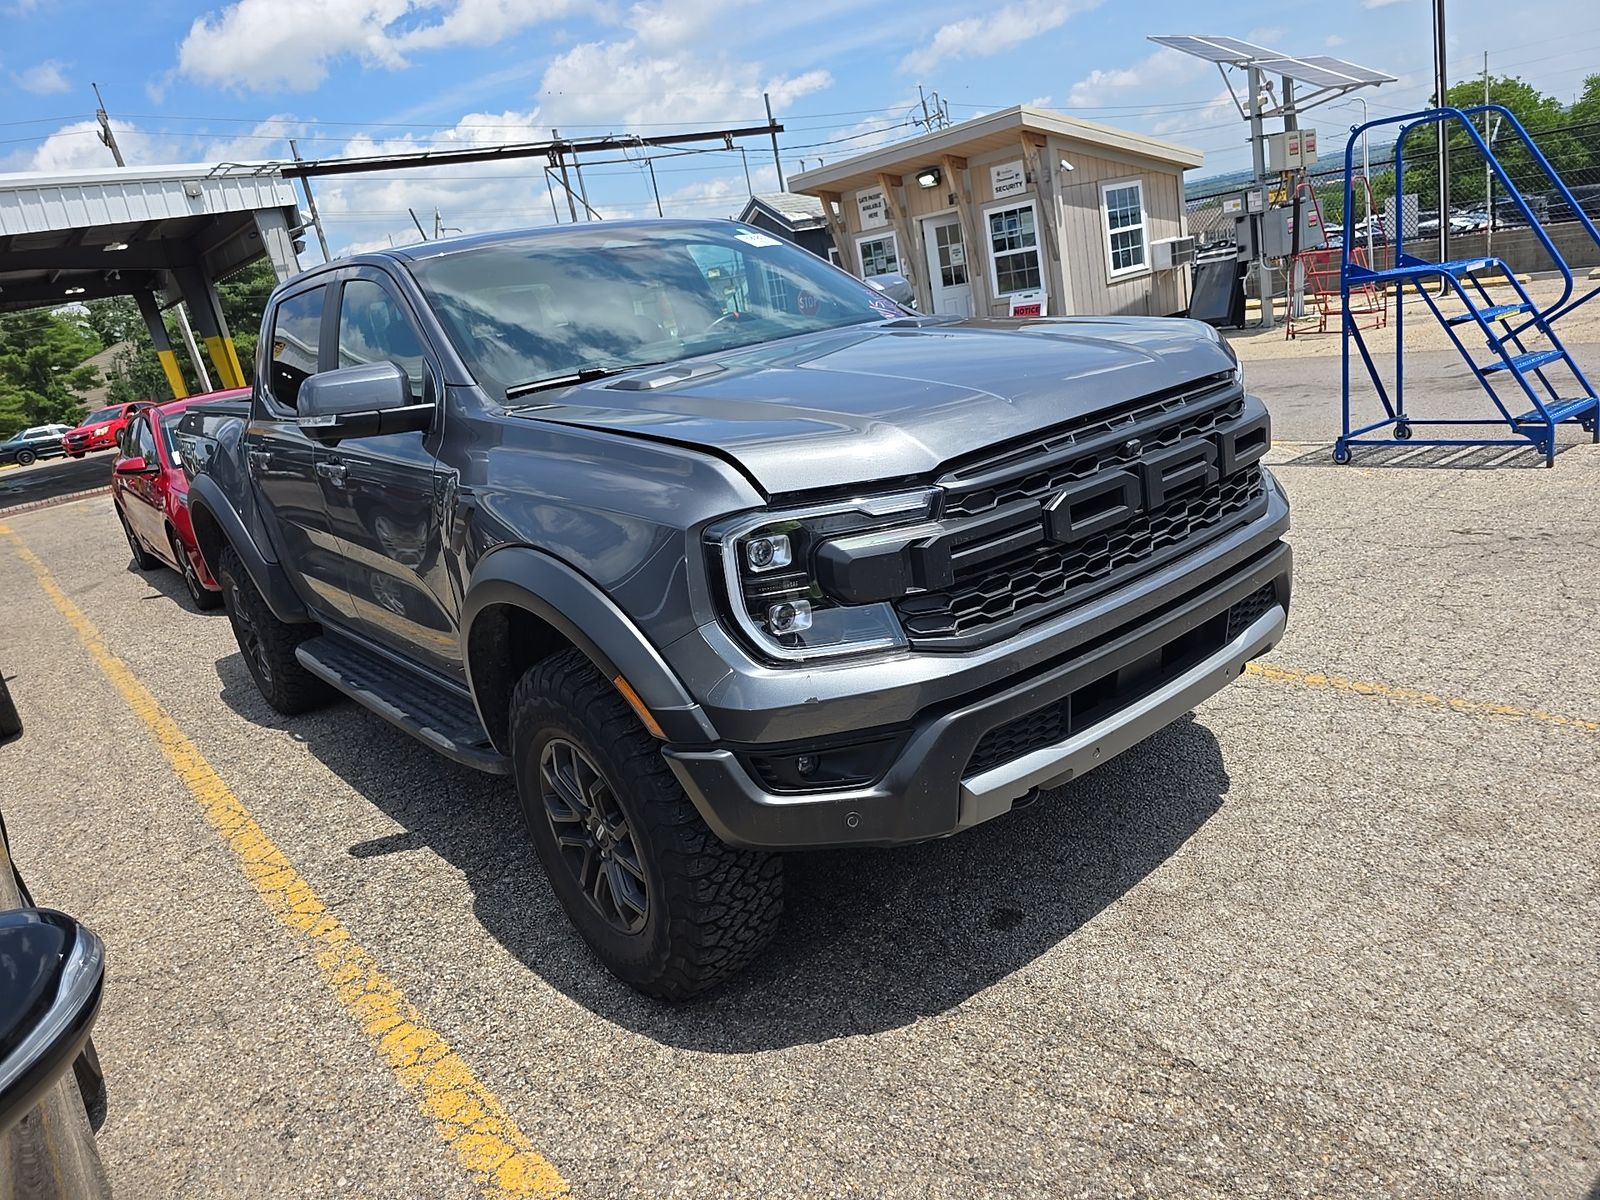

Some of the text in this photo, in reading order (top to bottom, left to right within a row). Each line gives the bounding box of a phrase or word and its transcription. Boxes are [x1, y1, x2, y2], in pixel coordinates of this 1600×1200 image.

[995, 181, 1023, 193] SECURITY
[858, 196, 868, 204] GATE
[863, 202, 881, 211] AVAILABLE
[1014, 305, 1041, 316] NOTICE
[912, 395, 1271, 590] FORD
